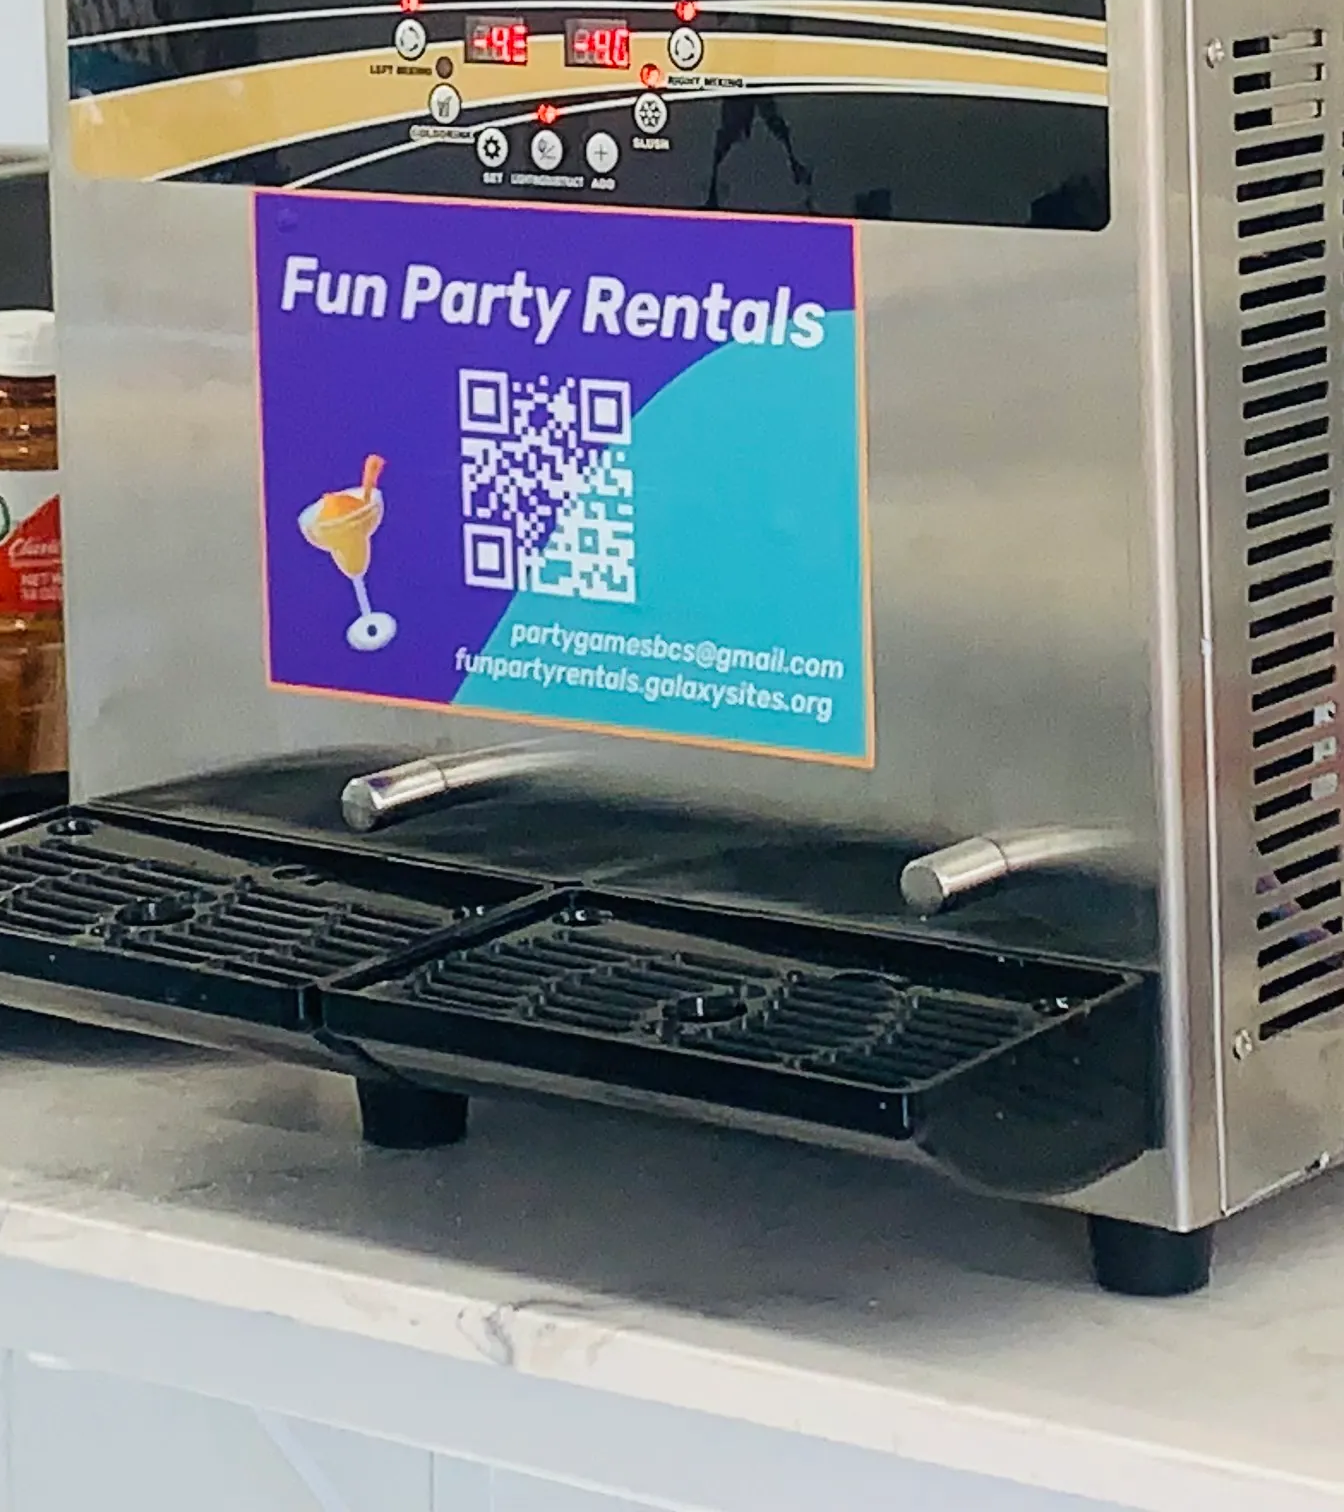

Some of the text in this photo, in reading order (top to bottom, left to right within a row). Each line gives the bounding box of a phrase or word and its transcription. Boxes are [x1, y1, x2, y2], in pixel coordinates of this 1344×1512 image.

[632, 137, 670, 151] SLUSH
[591, 178, 616, 191] ADD
[280, 255, 827, 349] Fun Party Rentals
[511, 622, 845, 680] partygamesbcs@gmail.com
[455, 646, 834, 723] funpartyrentals.galaxysites.org
